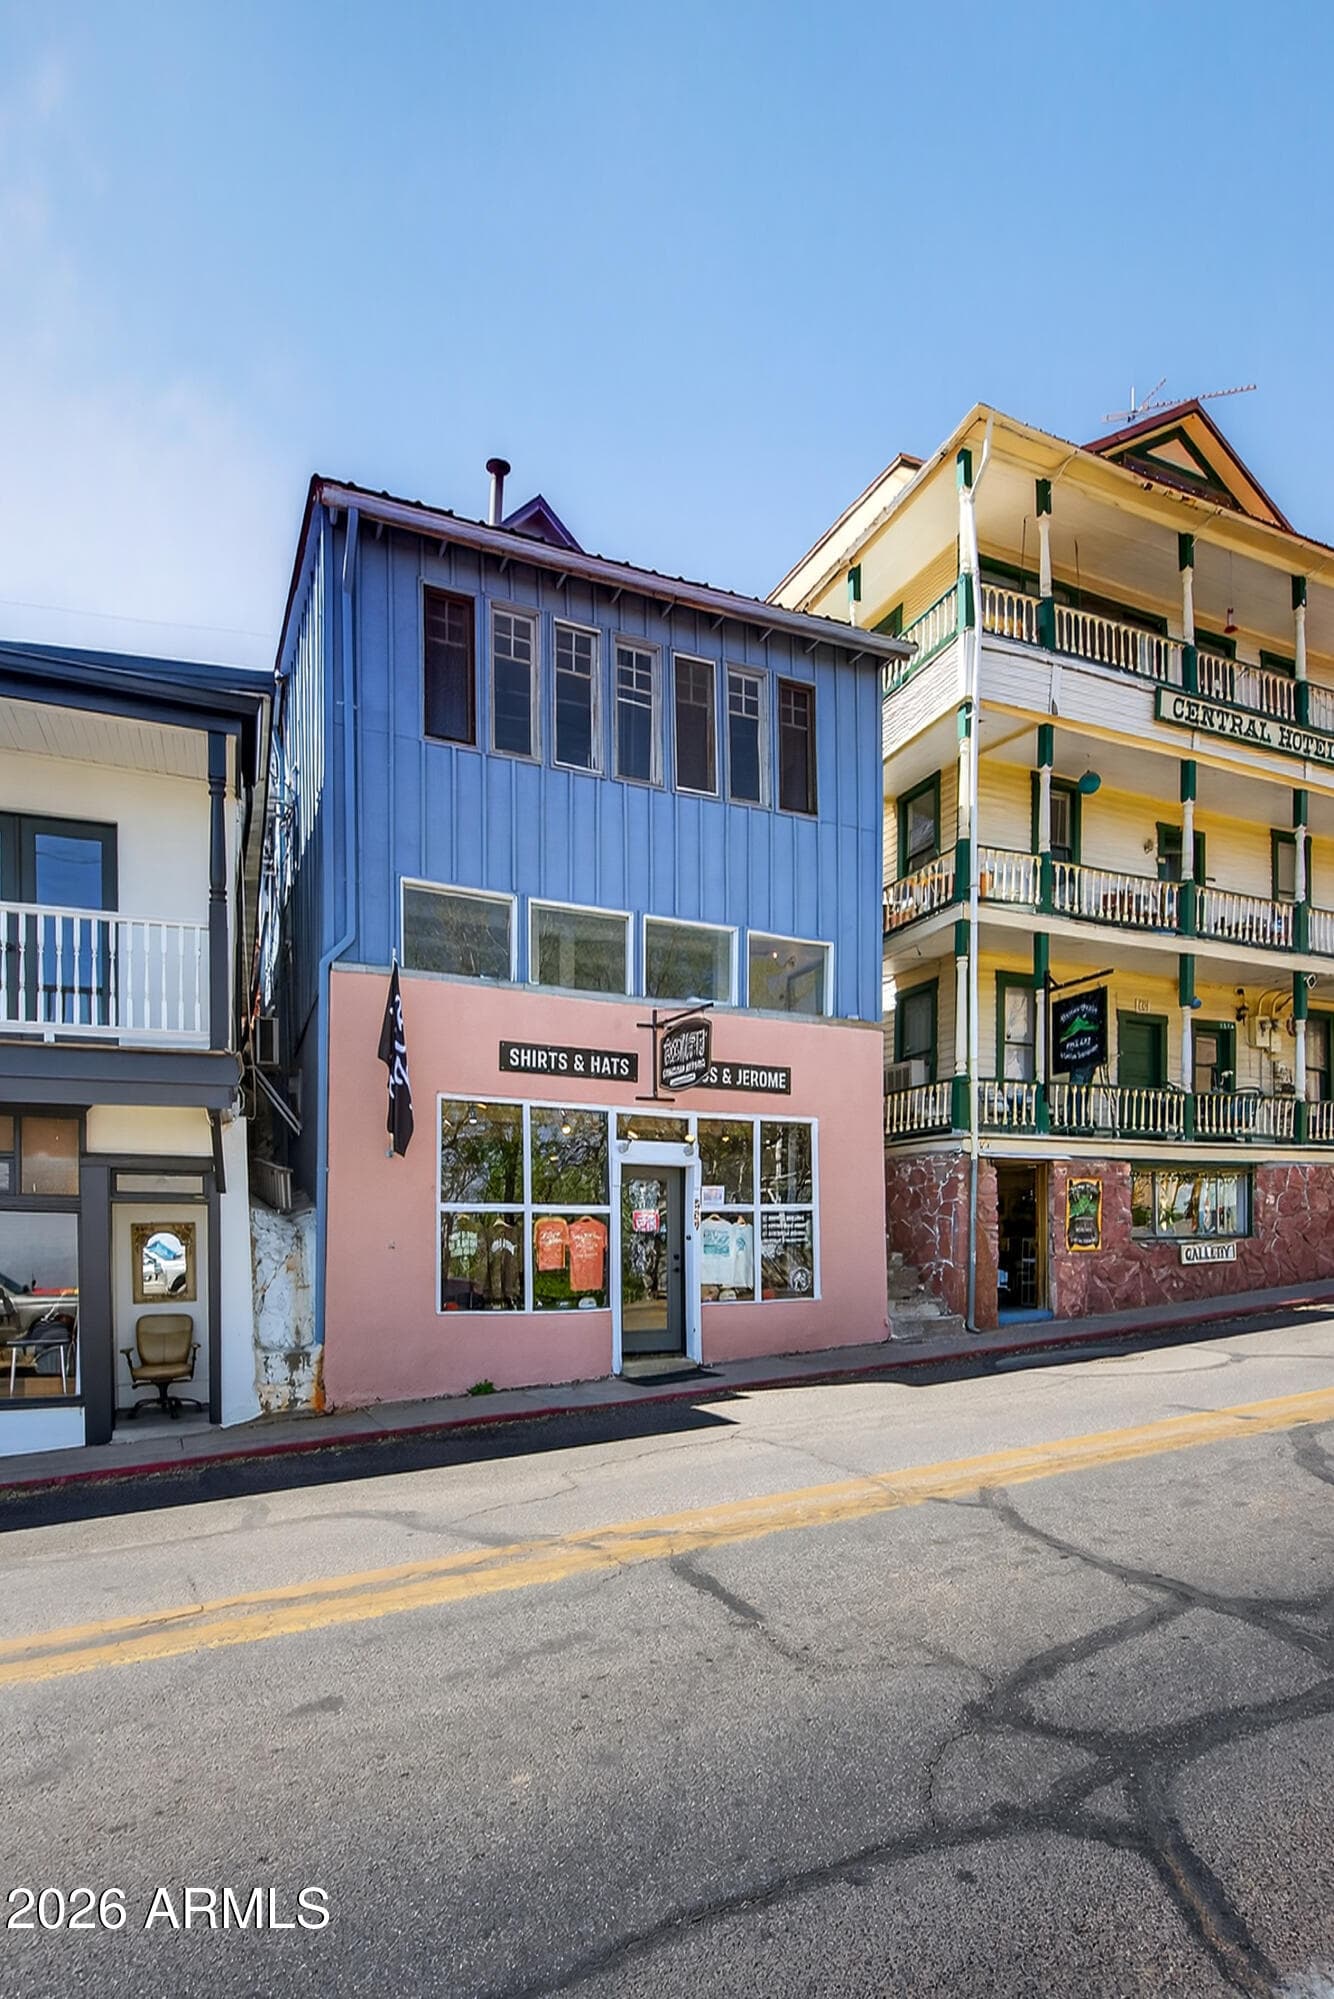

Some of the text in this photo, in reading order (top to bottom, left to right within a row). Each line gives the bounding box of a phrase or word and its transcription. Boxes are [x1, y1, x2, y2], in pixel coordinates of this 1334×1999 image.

[1172, 697, 1272, 744] CENTRAL
[509, 1047, 630, 1076] SHIRTS & HATS
[721, 1067, 732, 1085] &
[736, 1068, 787, 1090] JEROME
